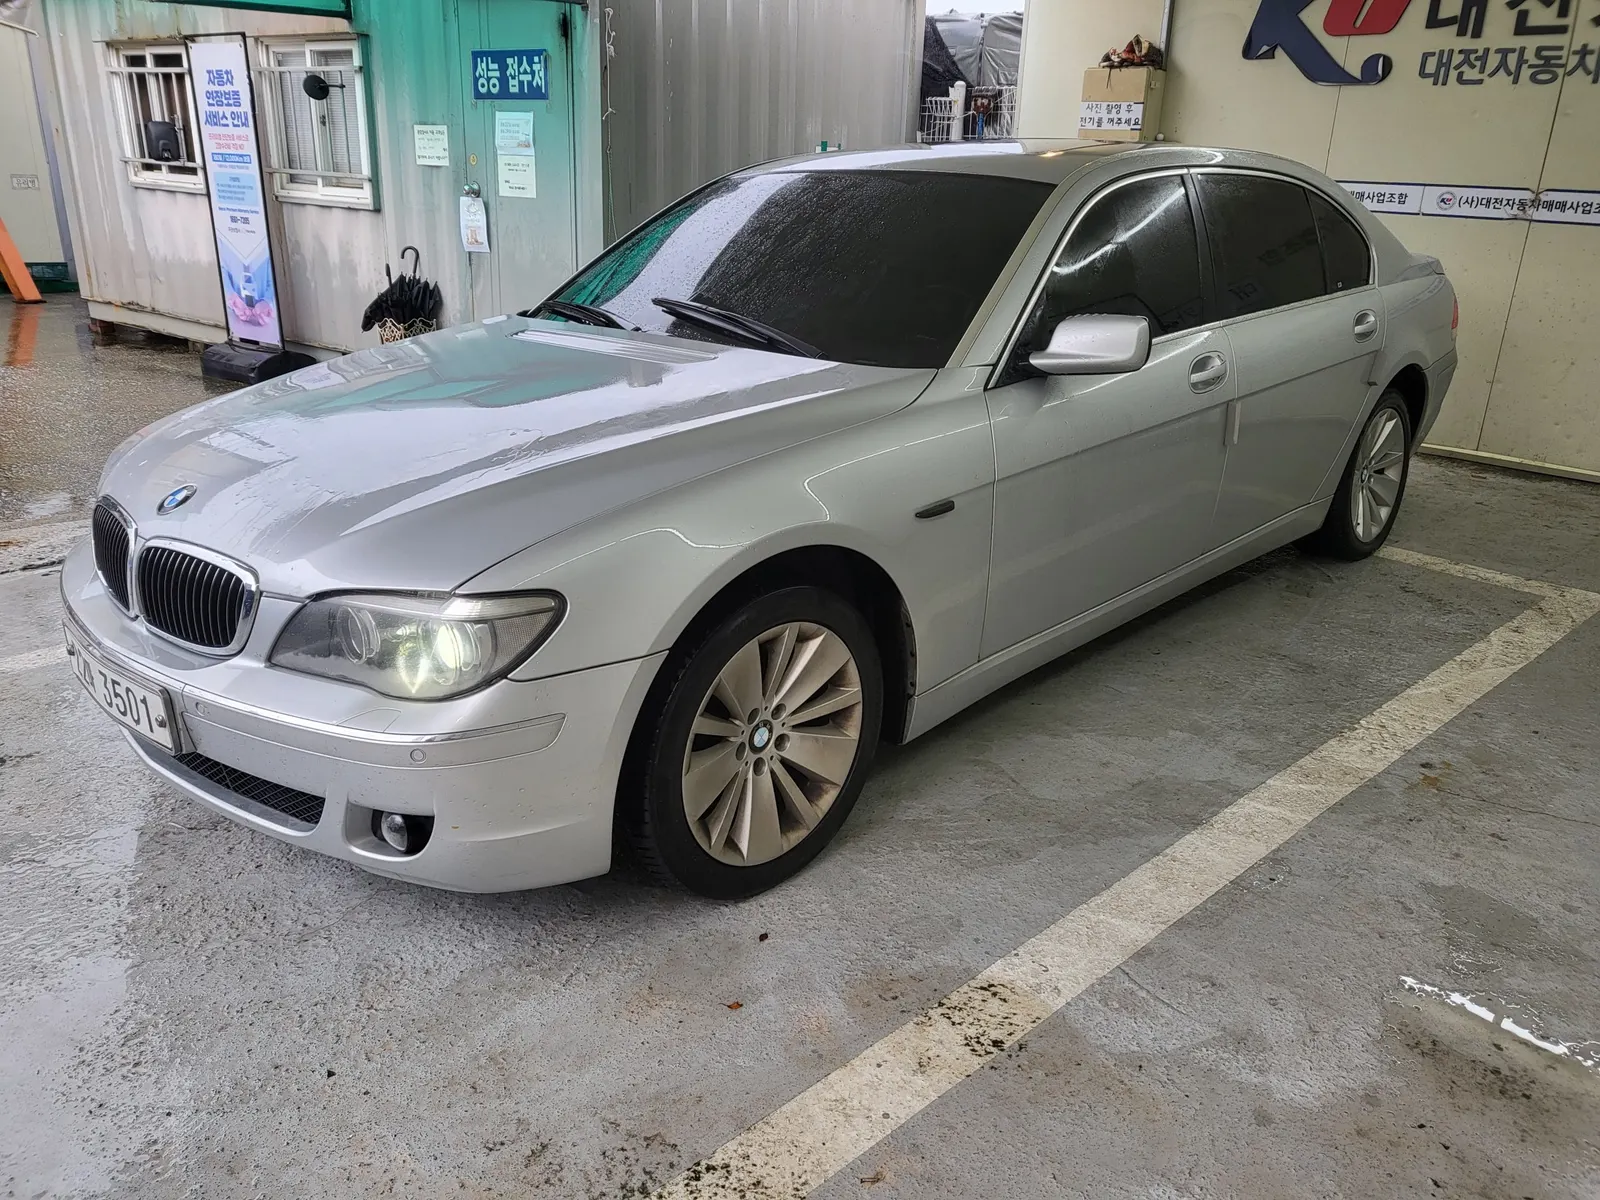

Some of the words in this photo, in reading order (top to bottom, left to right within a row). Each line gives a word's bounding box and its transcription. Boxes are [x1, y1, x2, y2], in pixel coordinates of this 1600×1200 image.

[206, 69, 234, 86] 자동차
[475, 56, 500, 94] 성능
[506, 55, 545, 93] 접수처
[205, 90, 241, 107] 연장보증
[1086, 103, 1101, 114] 사진
[1105, 103, 1122, 115] 촬영
[1125, 103, 1133, 113] 후
[205, 111, 229, 127] 서비스
[230, 111, 249, 127] 안내
[1080, 116, 1104, 128] 전기를
[1106, 116, 1141, 127] 꺼주세요
[98, 669, 155, 734] 3501
